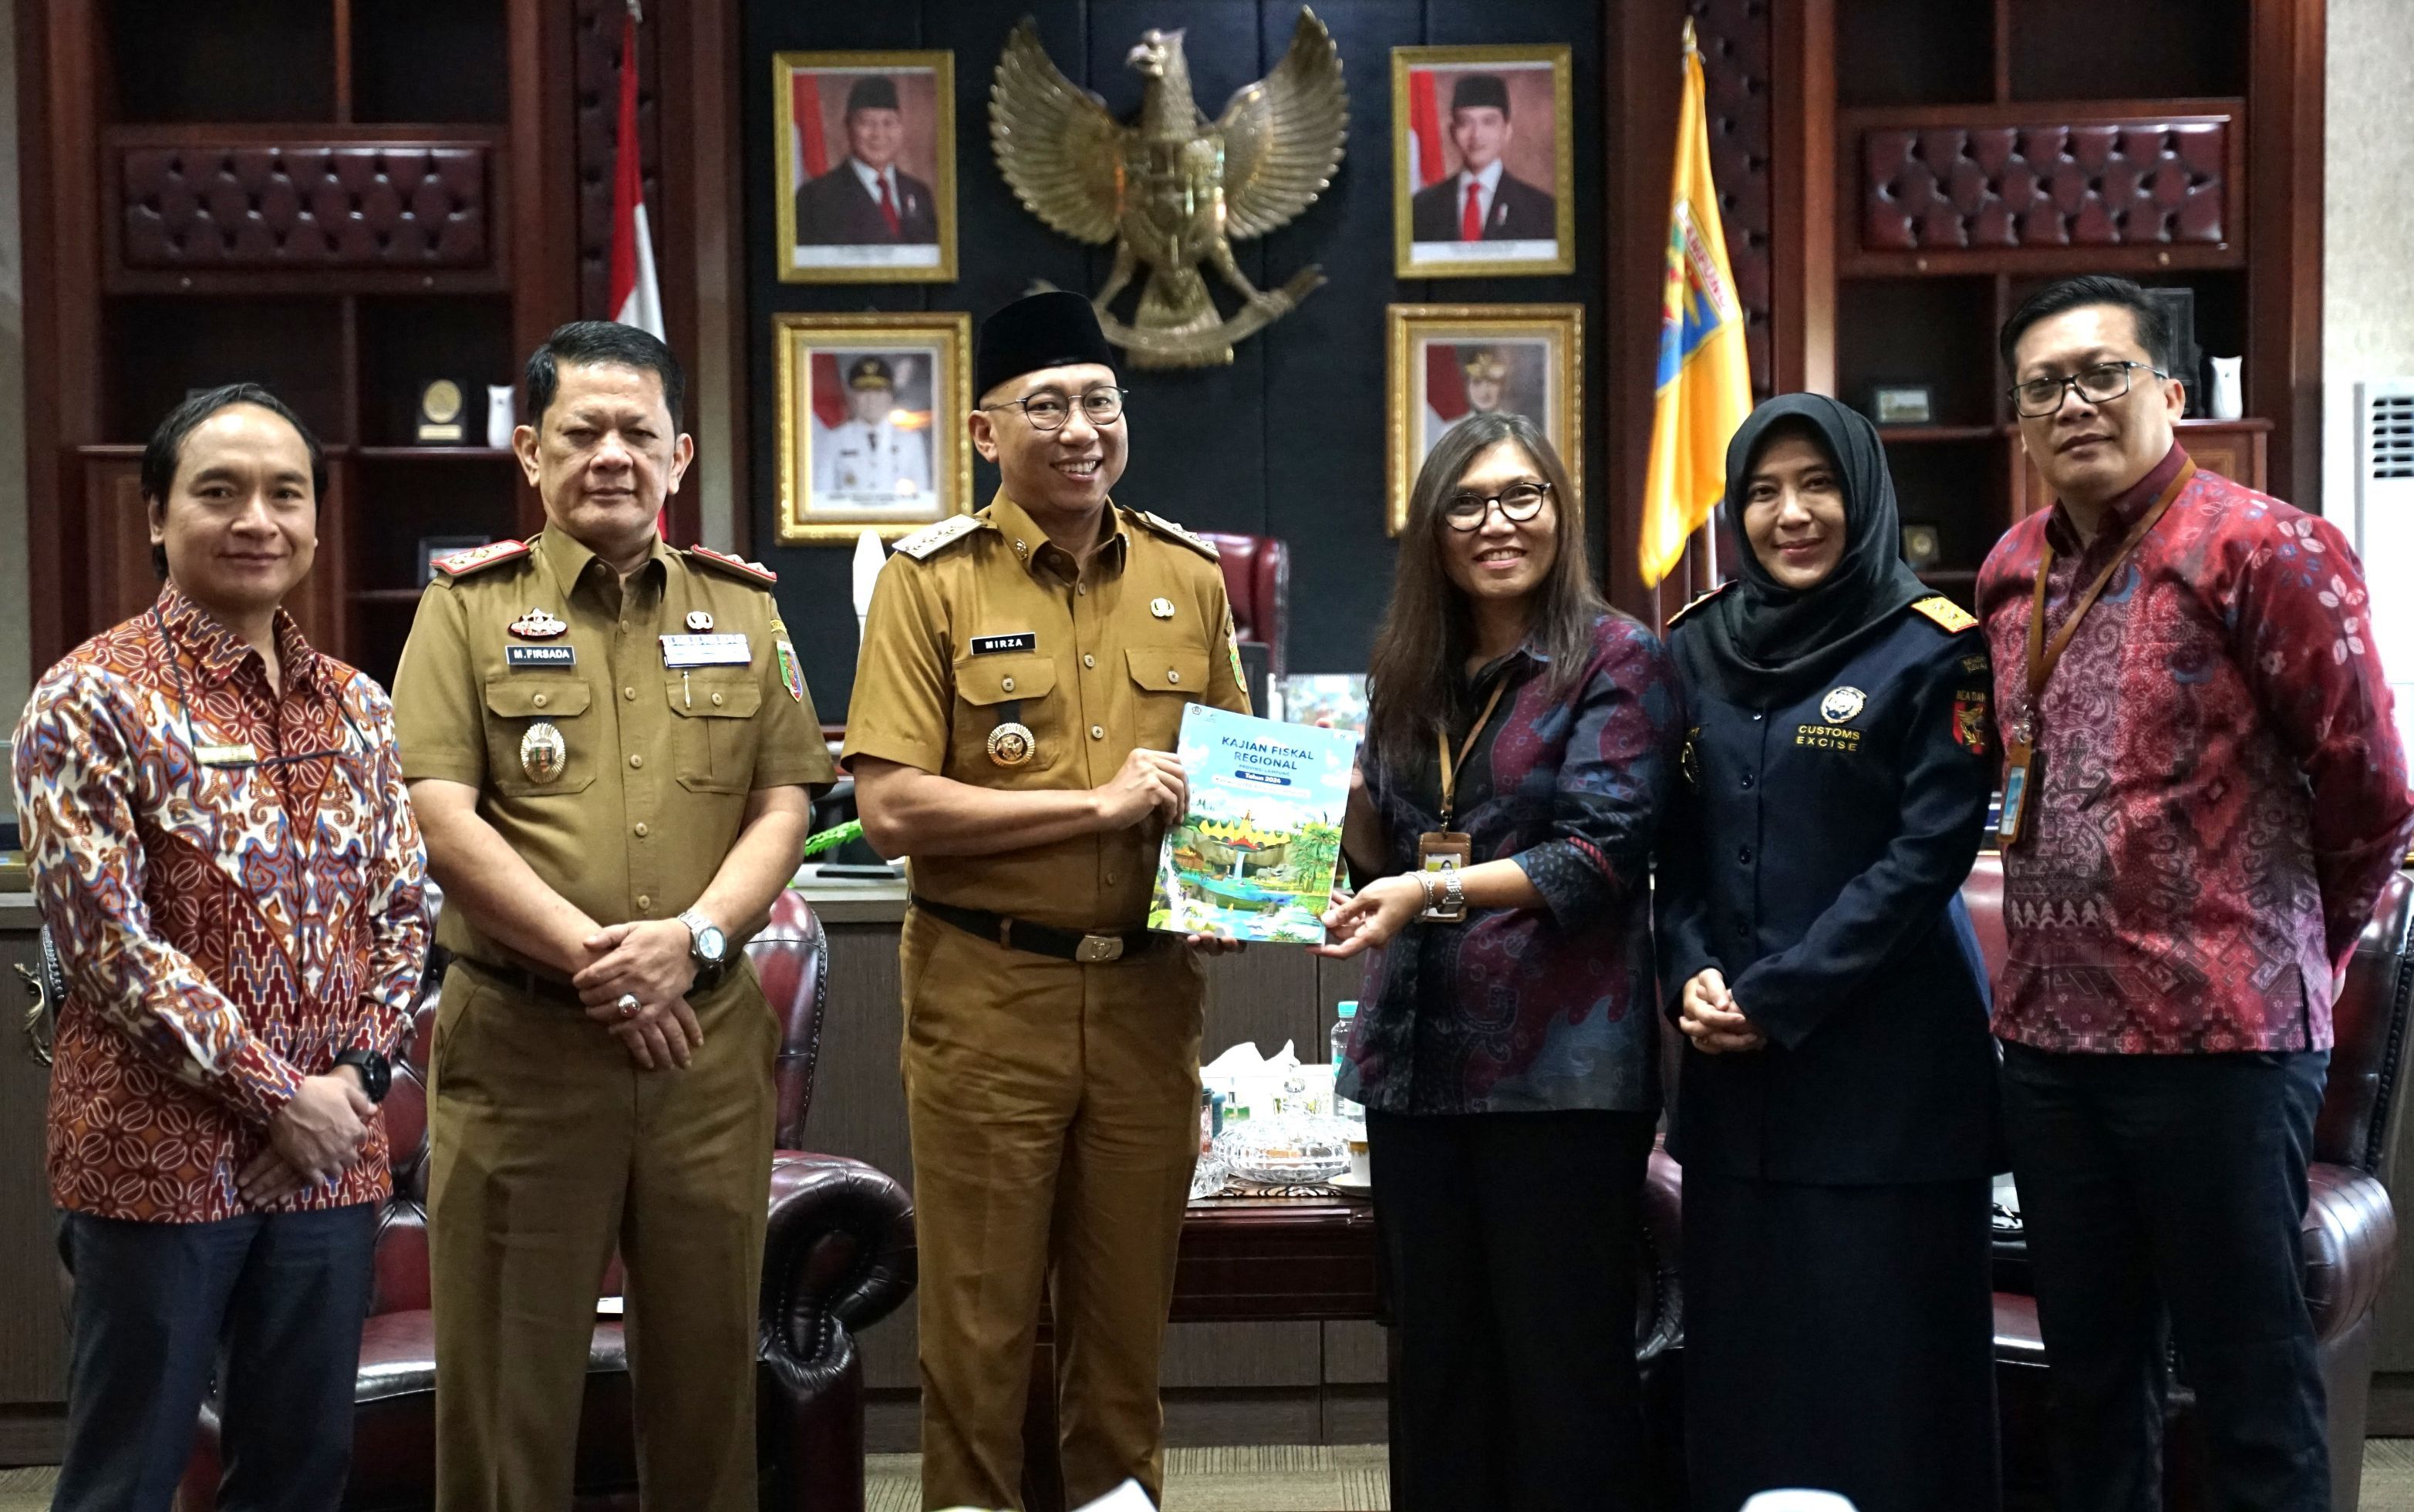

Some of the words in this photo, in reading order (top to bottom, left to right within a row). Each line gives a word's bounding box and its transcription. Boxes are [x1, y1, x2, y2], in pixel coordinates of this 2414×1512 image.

[985, 638, 1023, 649] MIRZA
[1799, 725, 1860, 740] CUSTOMS
[1222, 736, 1268, 753] KAJIAN
[1271, 746, 1314, 760] FISKAL
[1796, 736, 1858, 752] EXCISE
[1234, 751, 1298, 770] REGIONAL
[1245, 773, 1265, 781] Tahun
[1264, 776, 1281, 784] 2024
